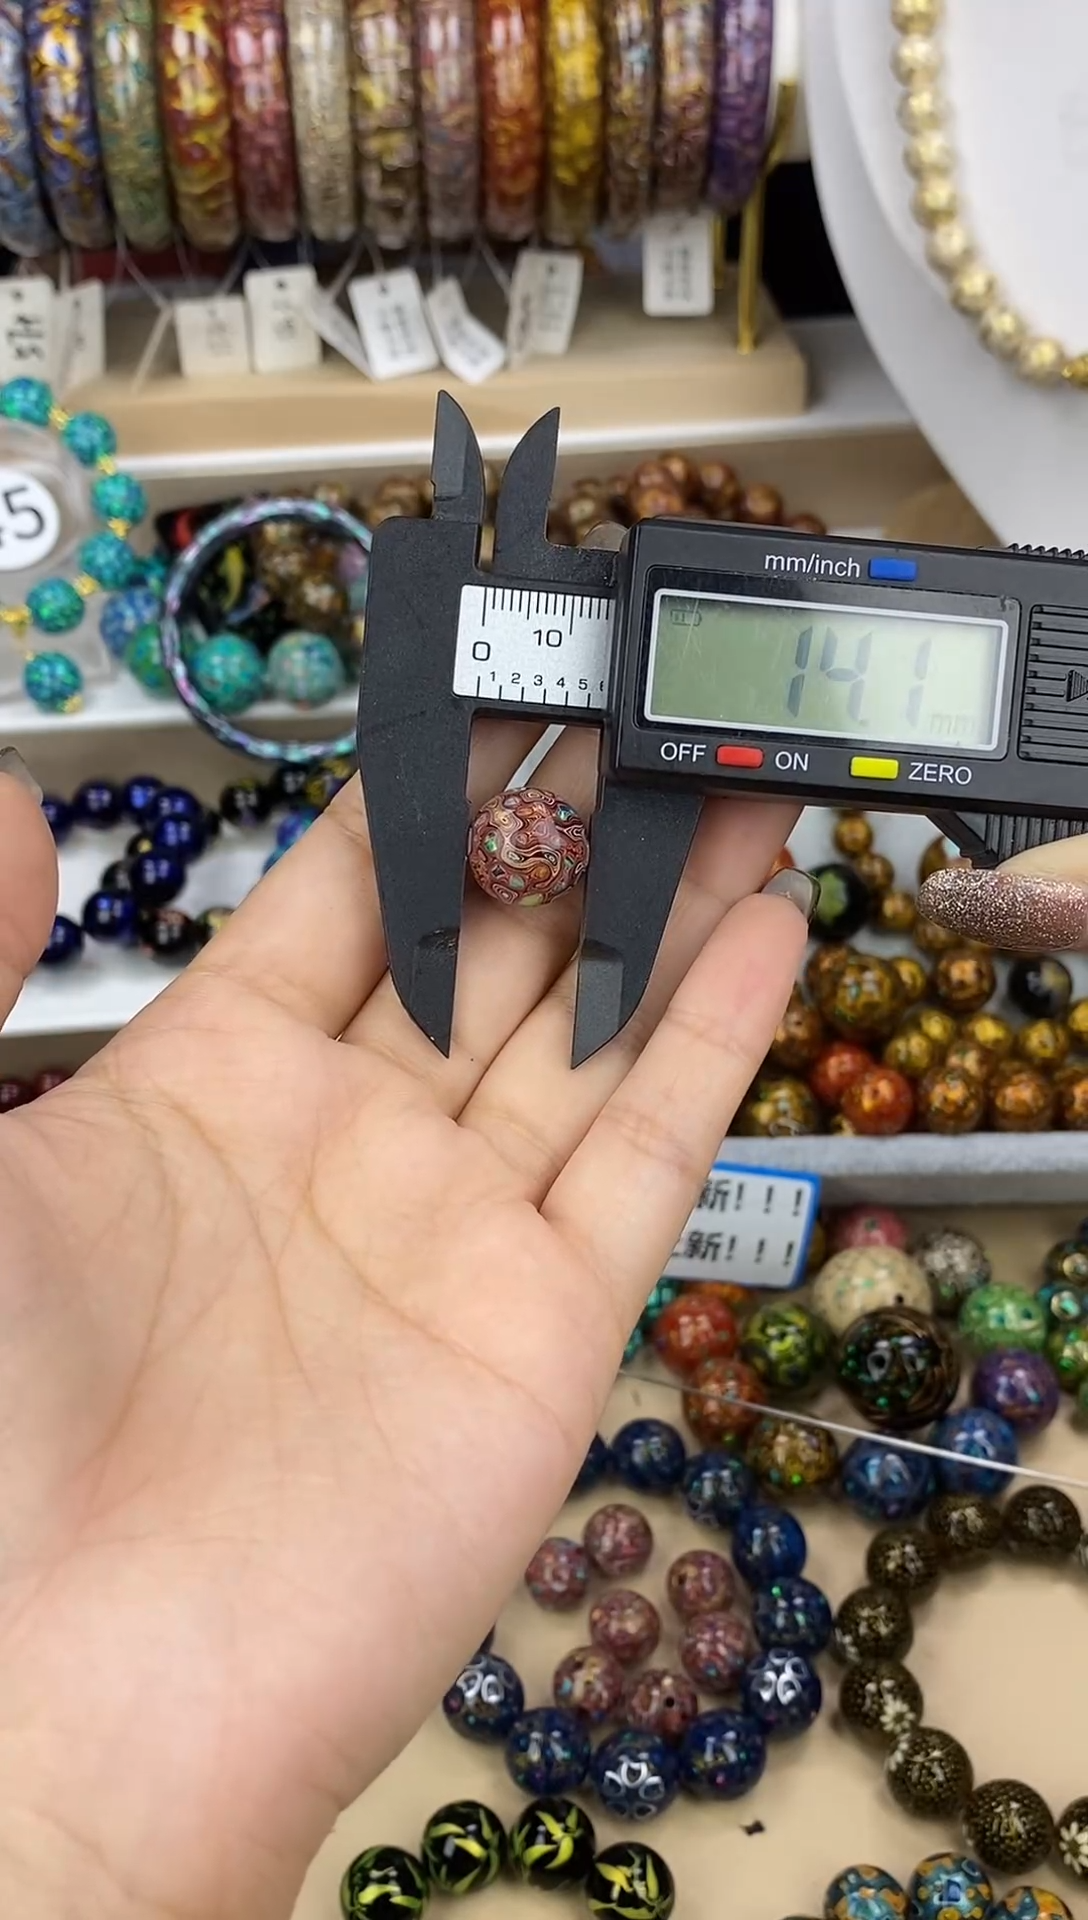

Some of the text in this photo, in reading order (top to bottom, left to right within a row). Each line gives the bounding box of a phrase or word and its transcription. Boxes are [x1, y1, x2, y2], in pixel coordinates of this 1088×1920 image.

[0, 486, 45, 549] 5
[764, 553, 861, 578] mm/inch
[472, 629, 563, 661] 0 10
[490, 671, 496, 682] 1
[511, 672, 521, 684] 2
[533, 674, 543, 686] 3
[556, 677, 566, 688] 4
[578, 678, 588, 691] 5
[660, 742, 972, 785] OFF ON ZERO
[671, 1230, 796, 1267] 新！！！
